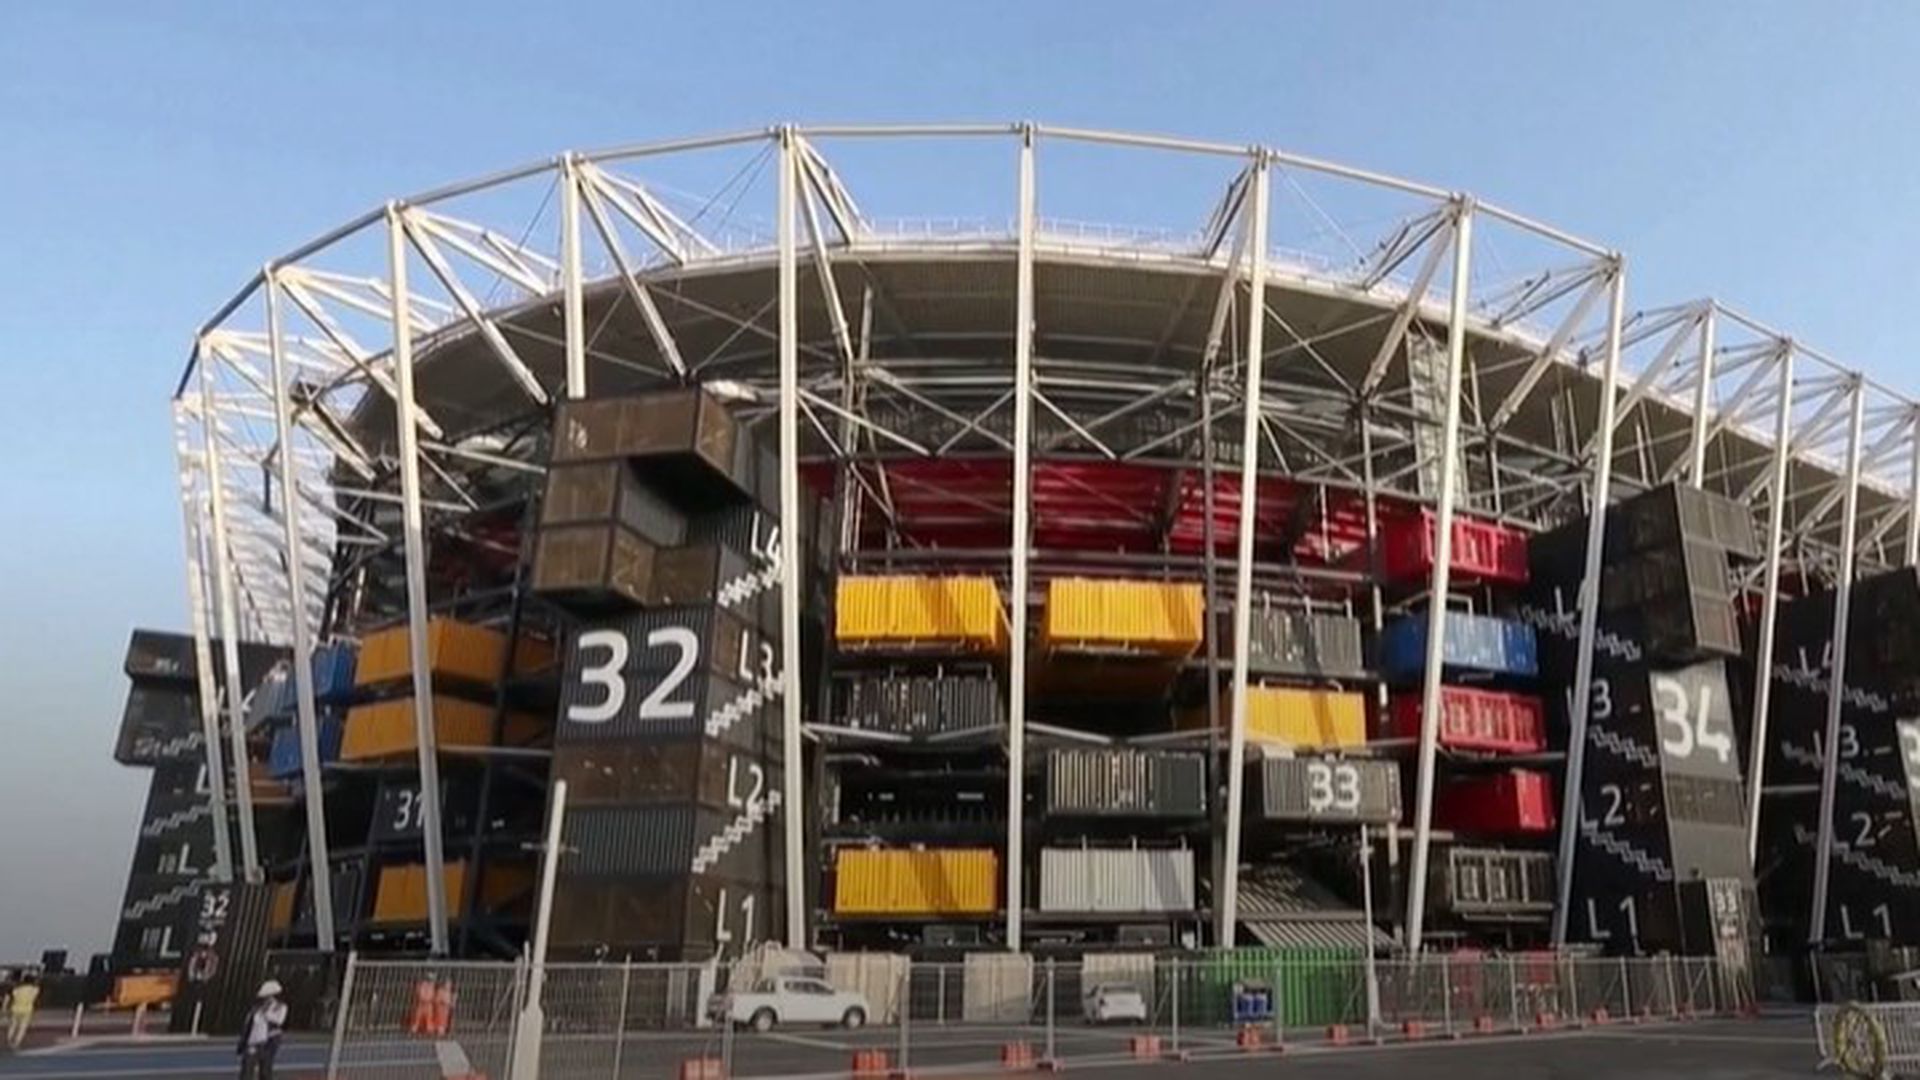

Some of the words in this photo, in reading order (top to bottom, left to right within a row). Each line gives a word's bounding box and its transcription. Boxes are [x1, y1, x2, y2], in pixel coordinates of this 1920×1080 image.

[751, 511, 783, 580] L4
[567, 627, 700, 722] 32
[739, 629, 774, 694] L3
[1656, 677, 1731, 763] 34
[728, 756, 764, 813] L2
[1307, 763, 1360, 809] 33
[717, 889, 754, 942] L1
[1588, 896, 1637, 939] L1
[1841, 903, 1892, 939] L1
